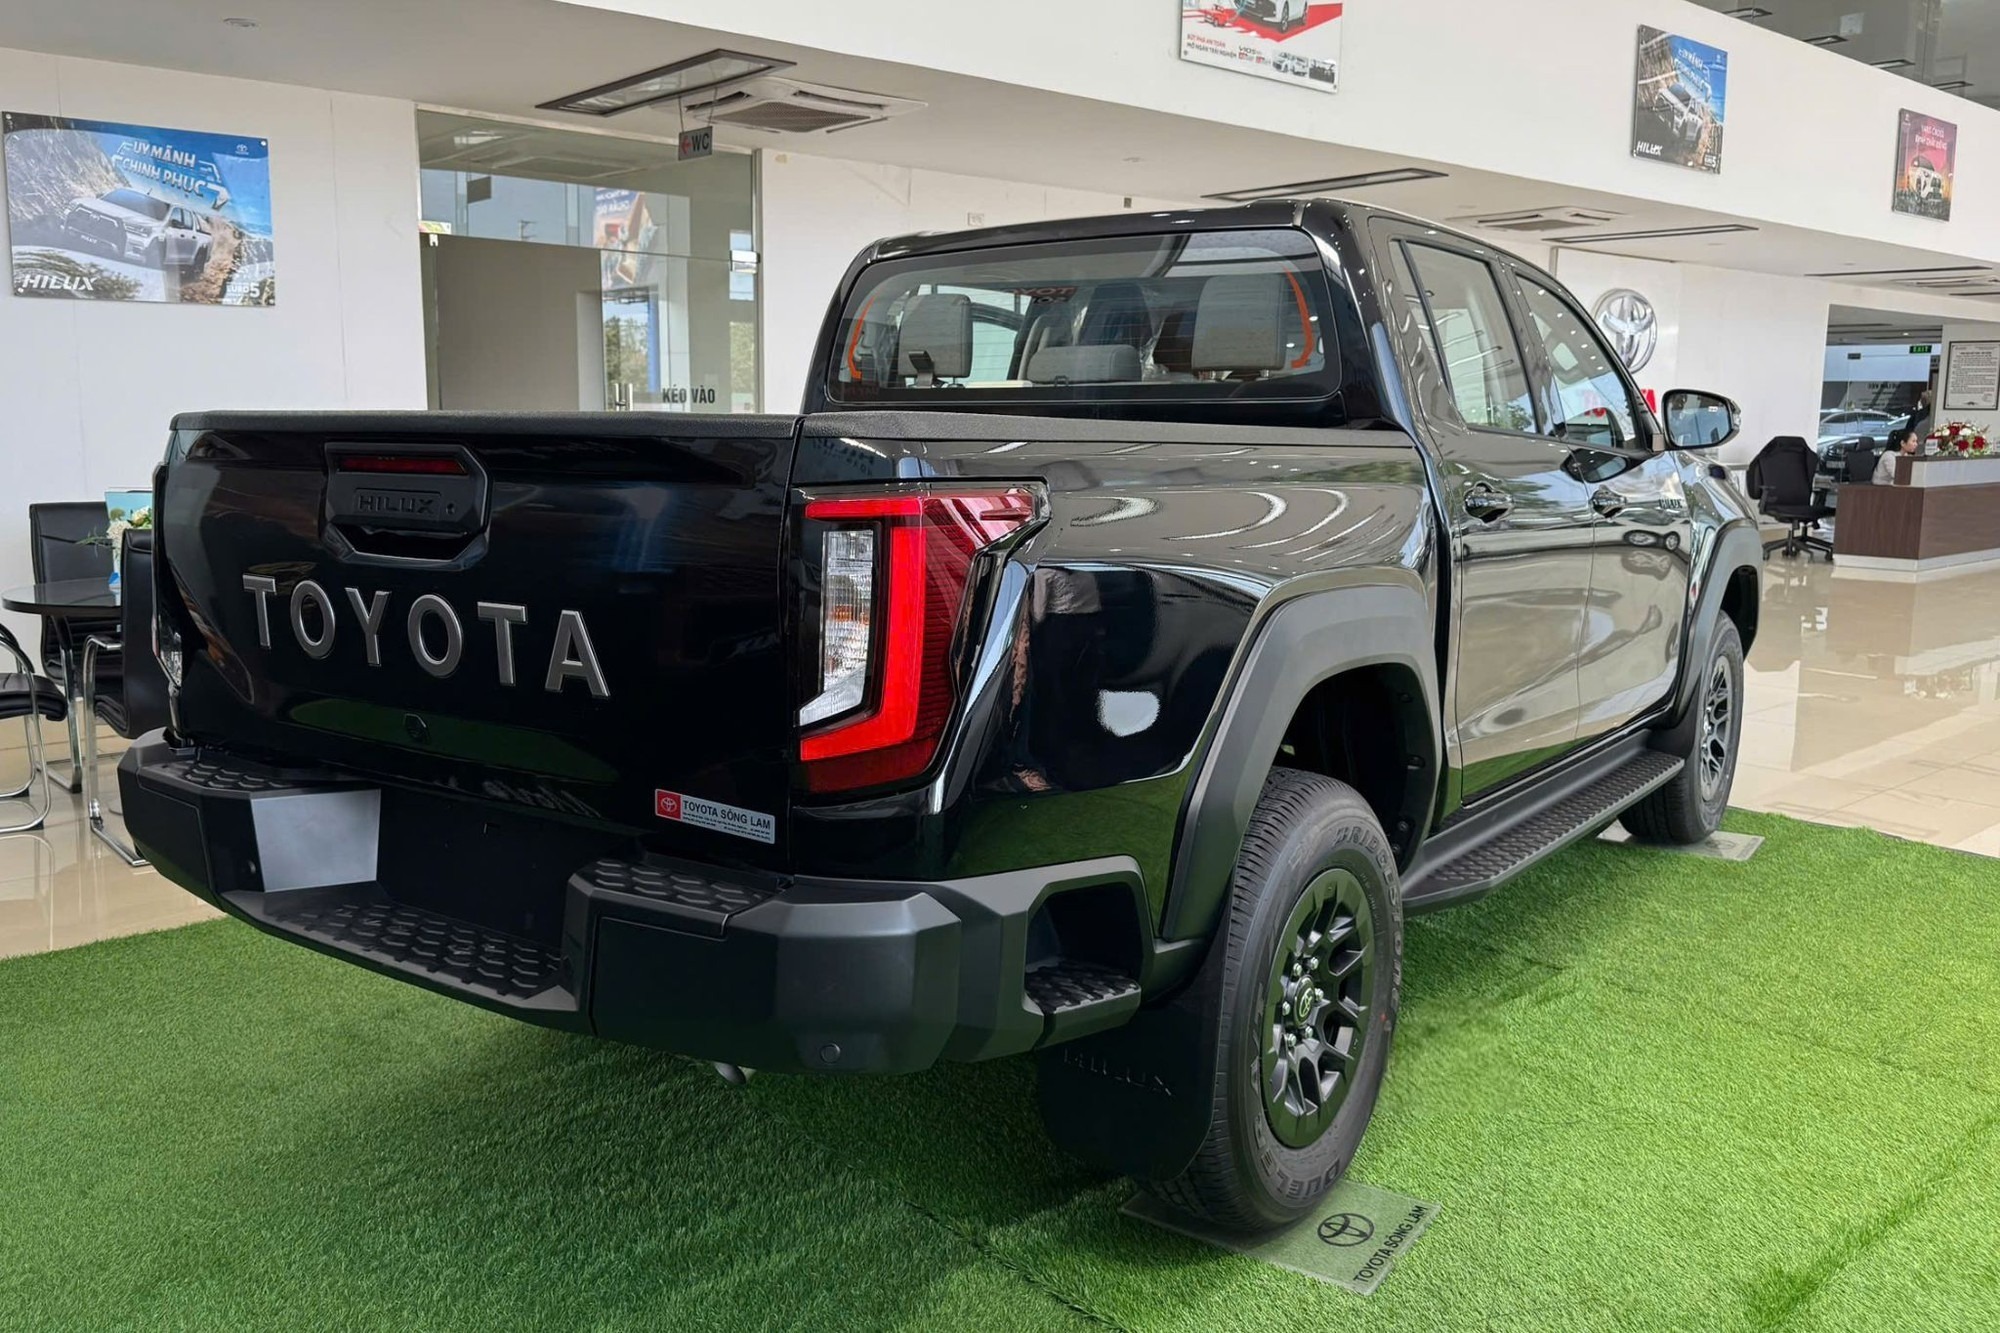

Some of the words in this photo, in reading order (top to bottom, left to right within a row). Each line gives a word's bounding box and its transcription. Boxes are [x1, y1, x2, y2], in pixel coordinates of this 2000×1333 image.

[691, 132, 710, 152] WC
[150, 145, 196, 168] MÃNH
[122, 158, 161, 180] CHINH
[163, 169, 206, 197] PHỤC
[250, 282, 260, 298] 5
[662, 384, 687, 404] KÉO
[690, 385, 716, 404] VÀO
[358, 495, 434, 514] HILUX
[242, 574, 612, 699] TOYOTA
[683, 800, 718, 817] TOYOTA
[720, 808, 748, 824] SÔNG
[750, 817, 770, 830] LAM
[1353, 1249, 1394, 1282] TOYOTA
[1384, 1223, 1413, 1248] SÔNG
[1404, 1205, 1428, 1224] LAM
